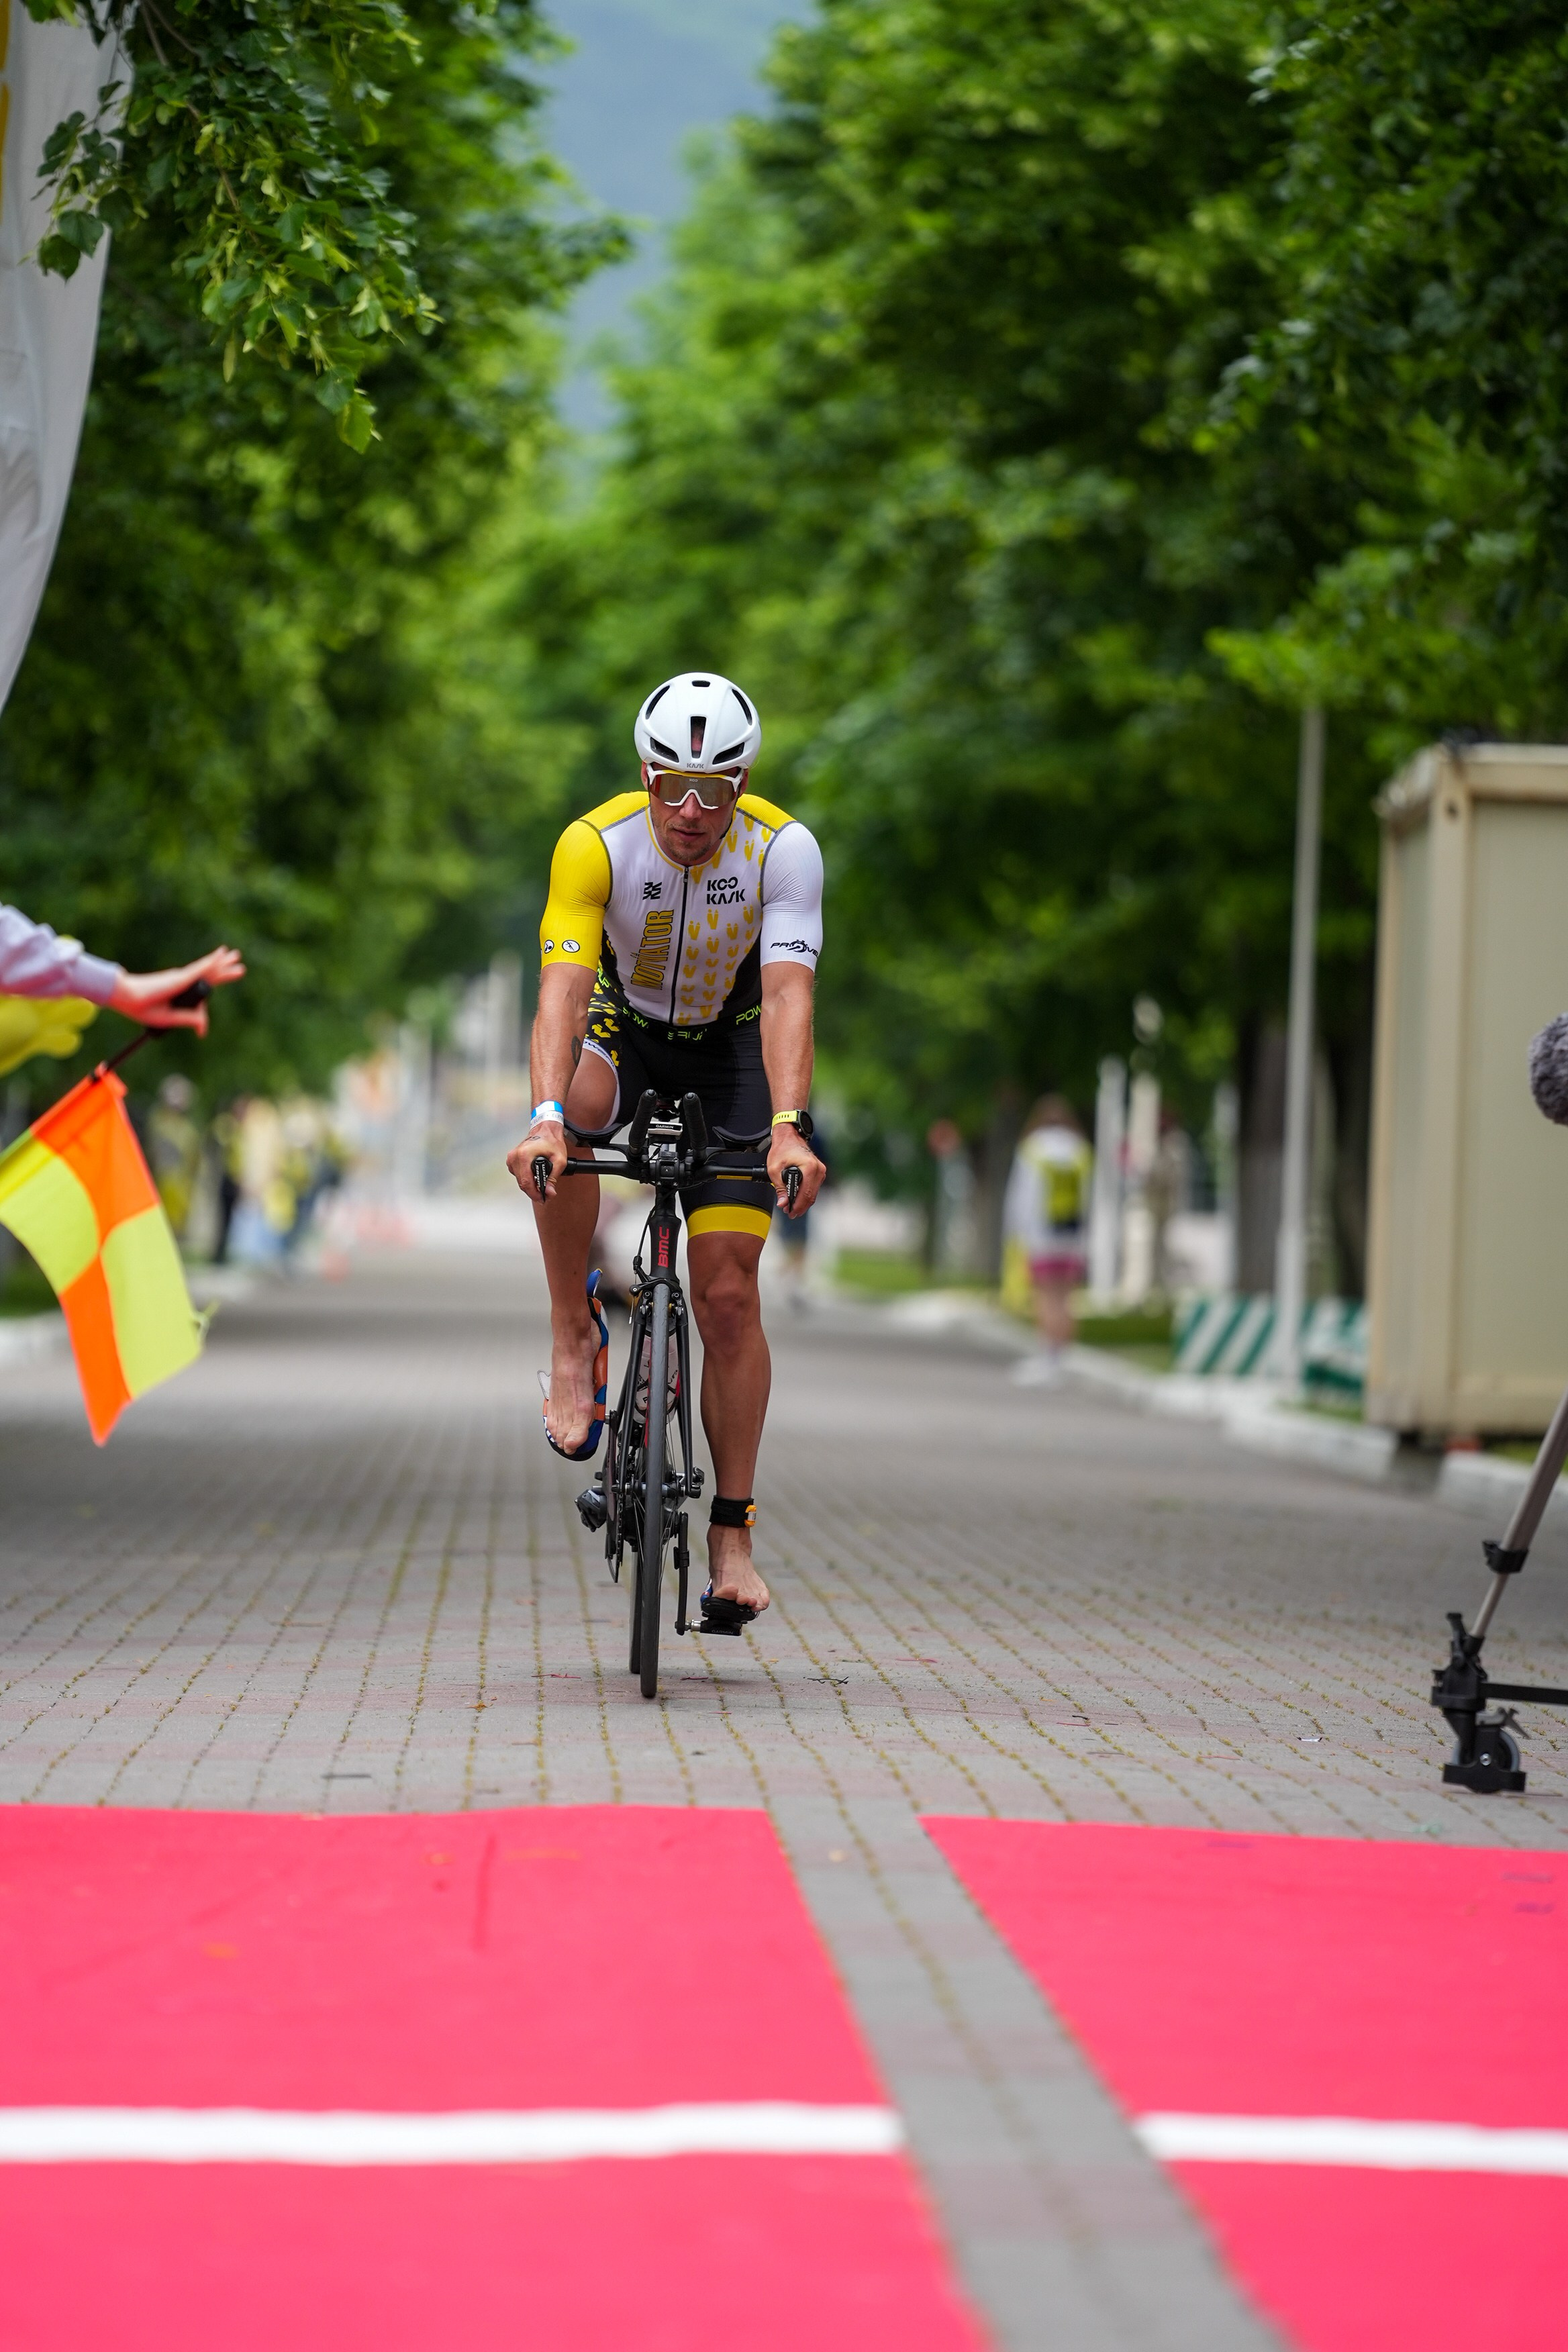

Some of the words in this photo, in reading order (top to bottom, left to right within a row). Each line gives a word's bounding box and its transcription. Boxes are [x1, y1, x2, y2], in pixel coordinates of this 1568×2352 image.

[707, 877, 738, 891] KOO
[707, 889, 746, 904] KASK
[658, 1226, 669, 1268] BMC
